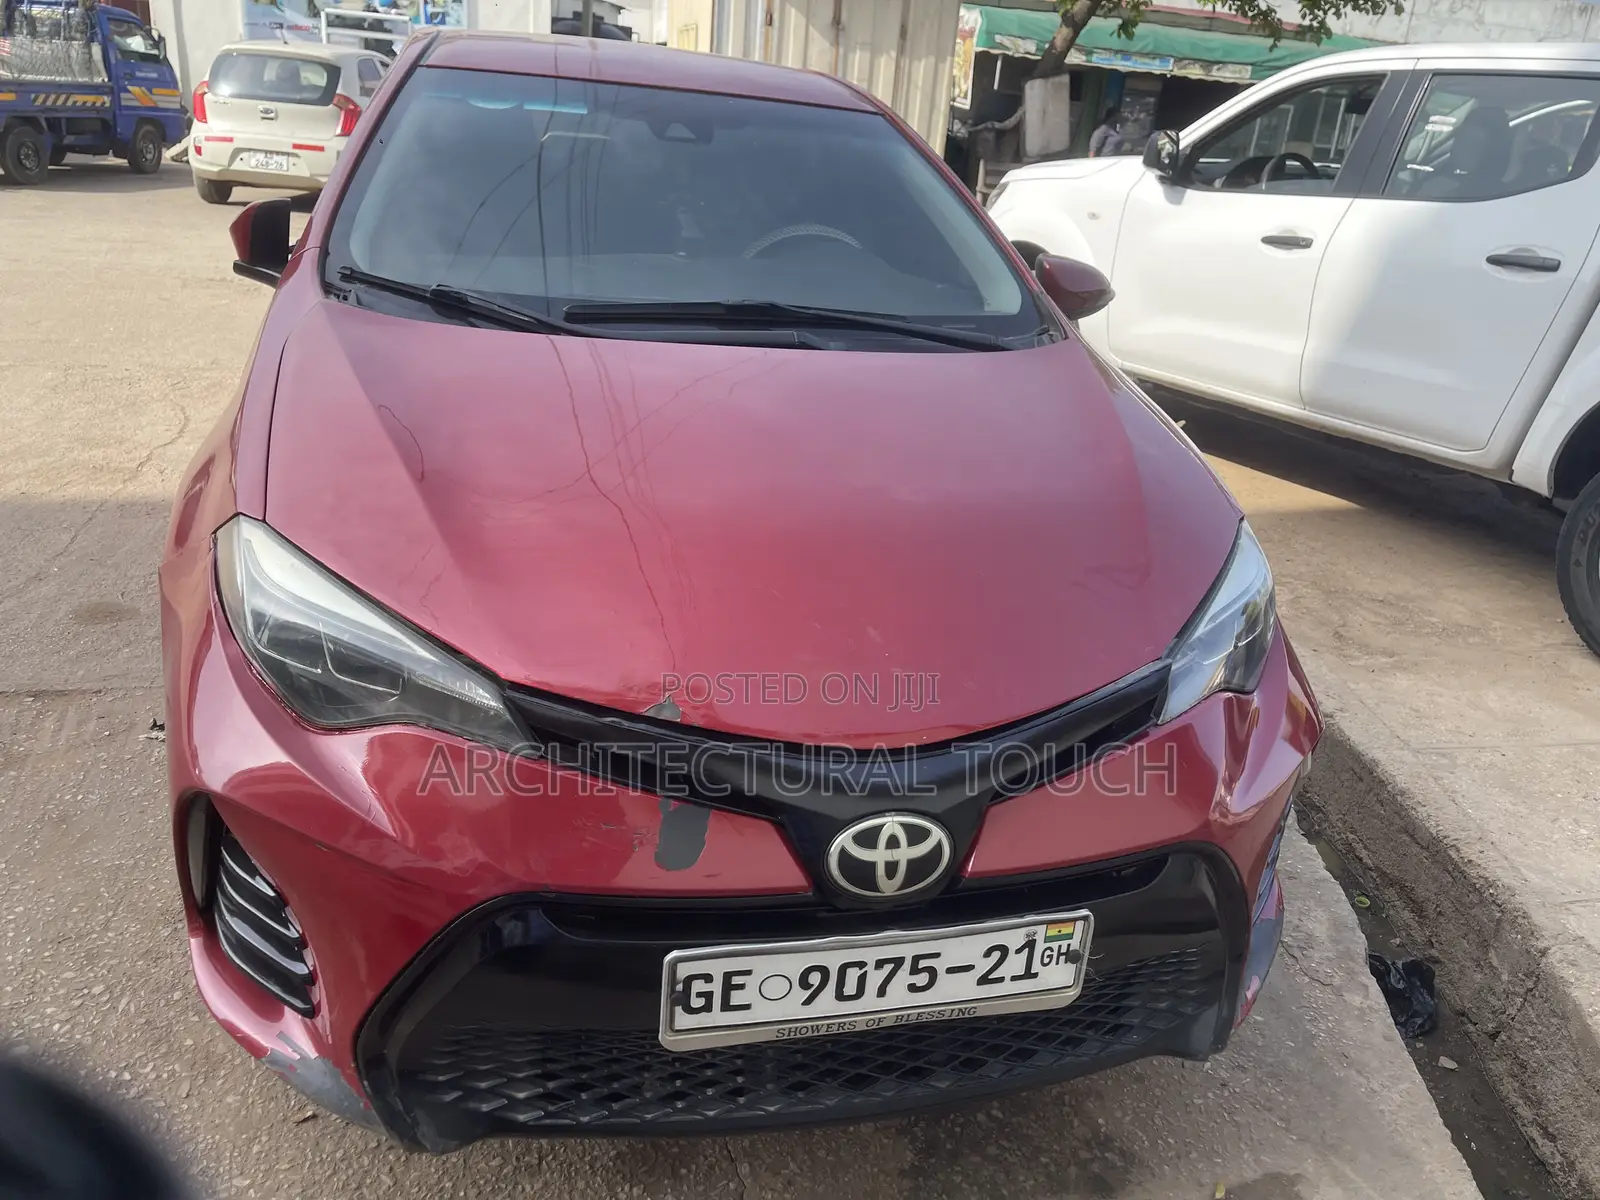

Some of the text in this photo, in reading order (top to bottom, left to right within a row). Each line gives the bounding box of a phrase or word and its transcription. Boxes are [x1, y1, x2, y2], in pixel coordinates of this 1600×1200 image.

[681, 938, 1072, 1015] GE 9075-21 GH
[775, 1006, 978, 1038] SHOWERS OF BLESSING
